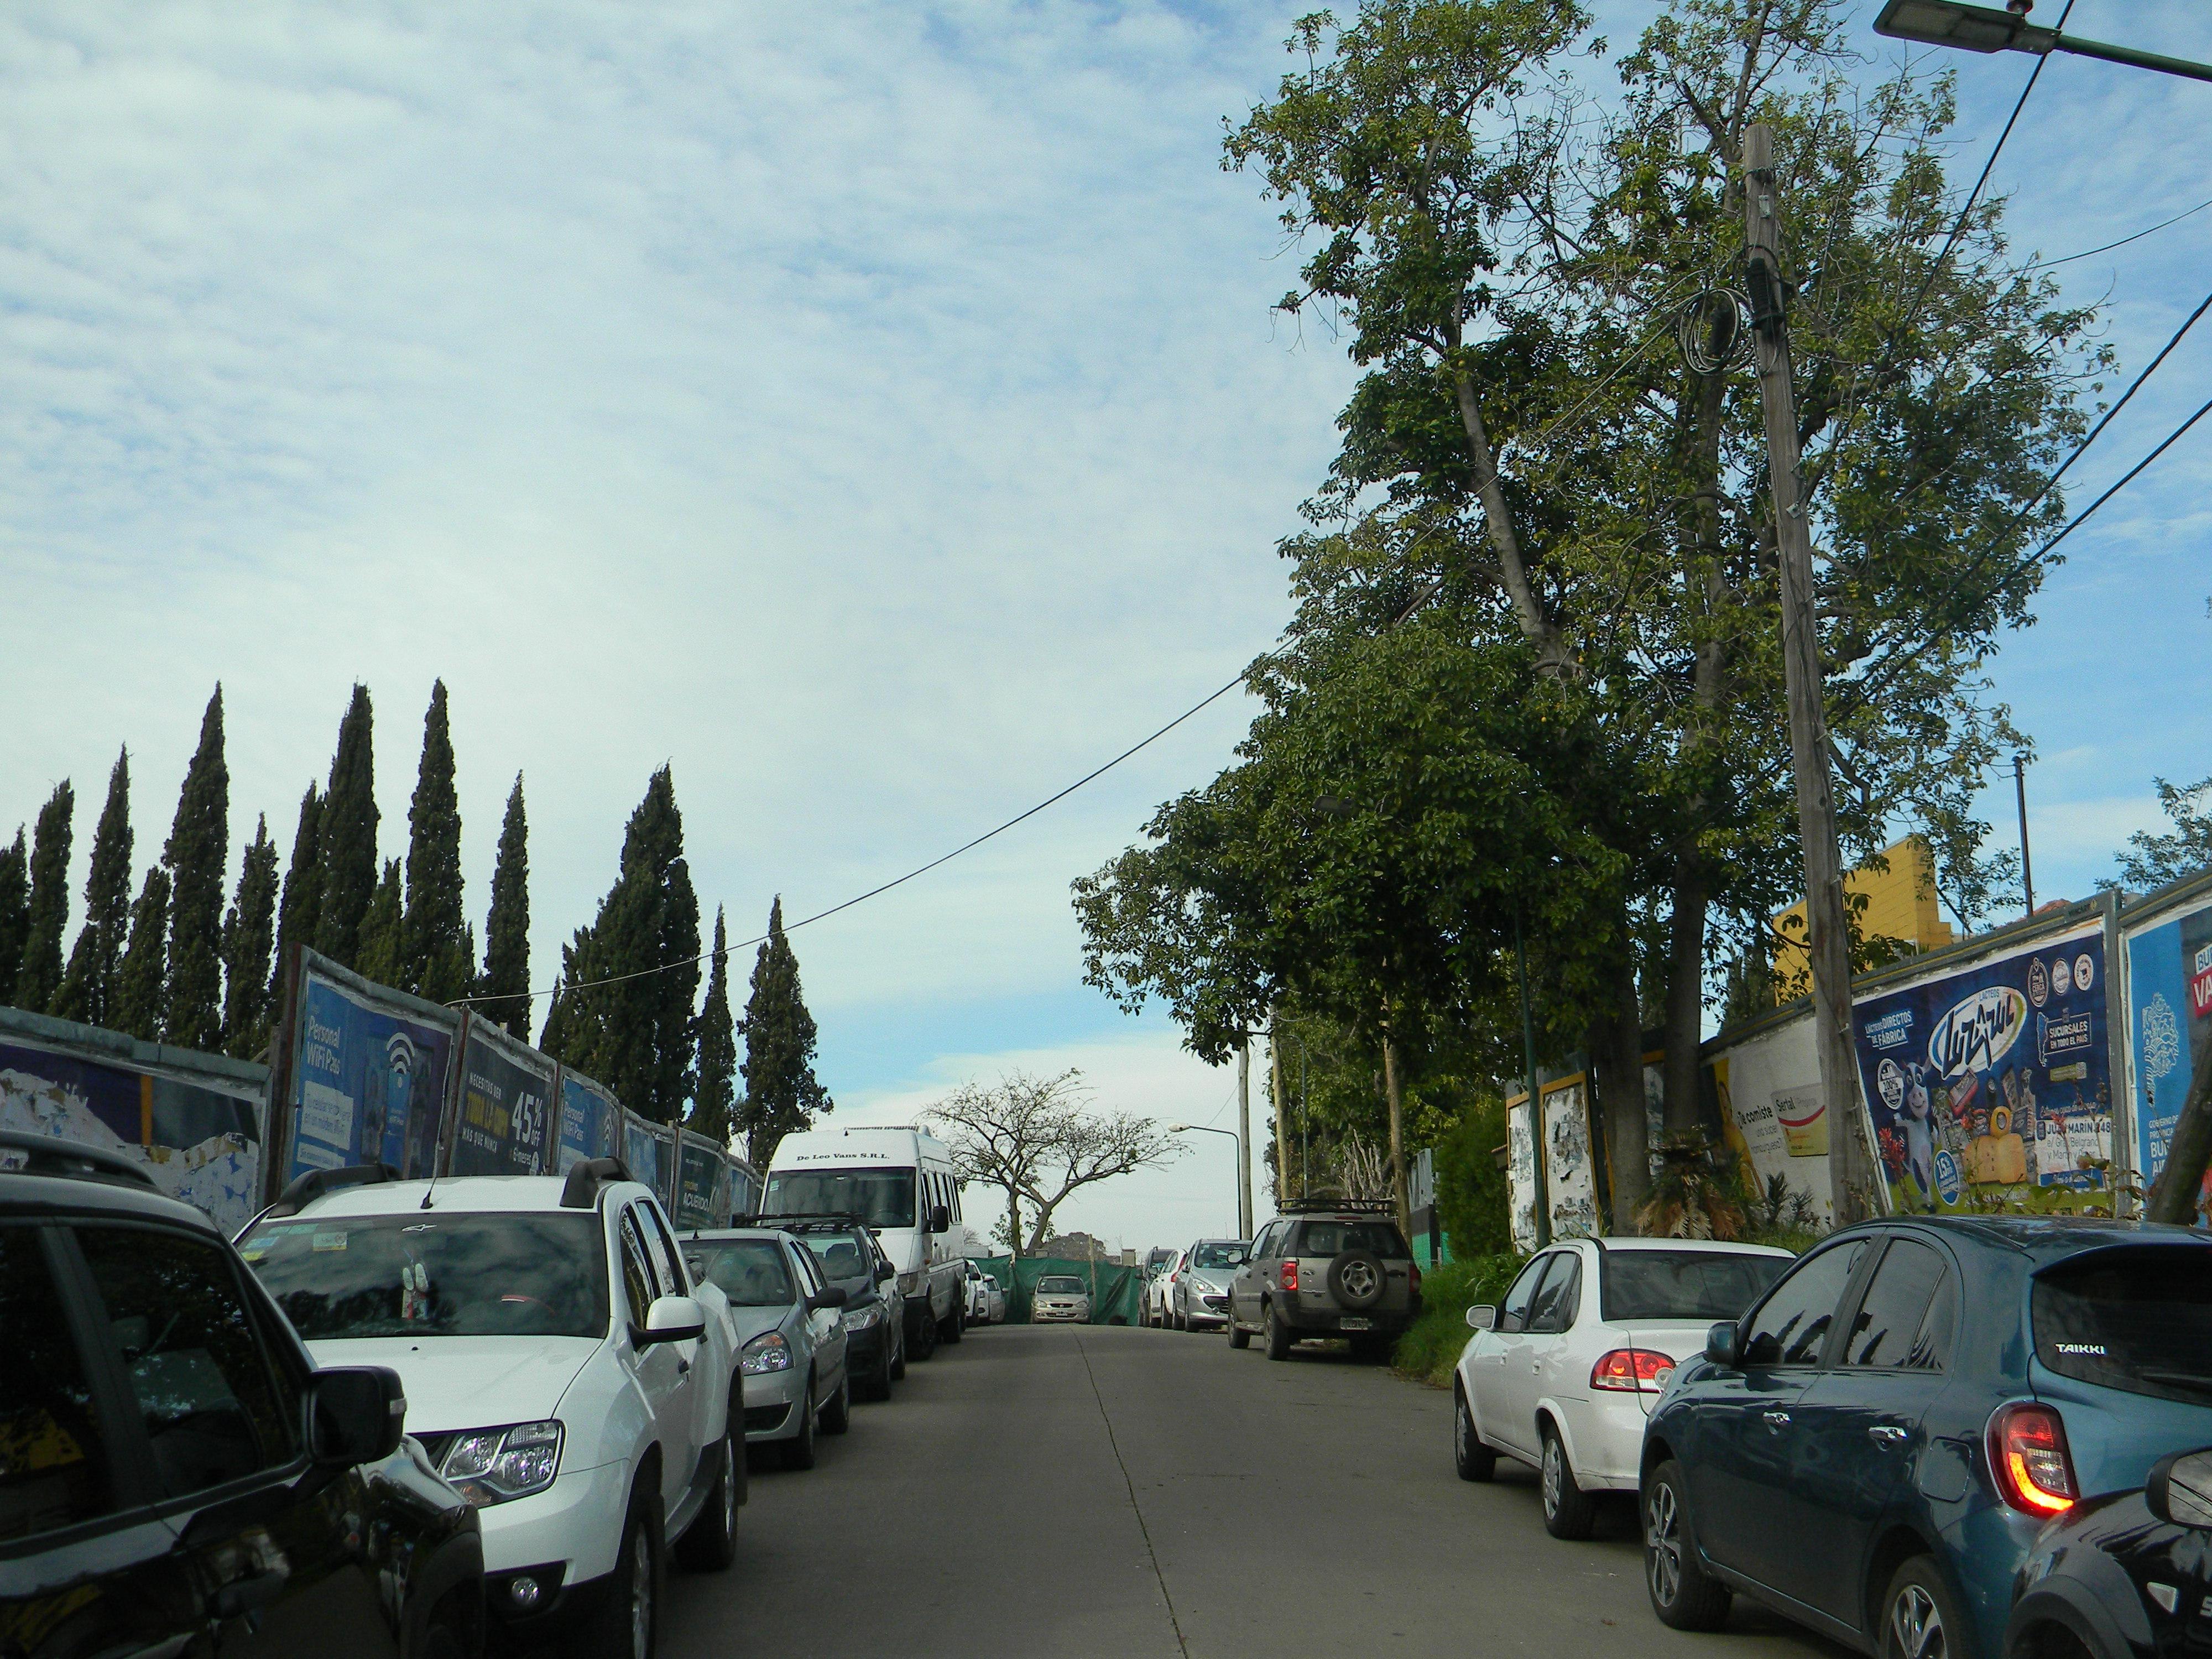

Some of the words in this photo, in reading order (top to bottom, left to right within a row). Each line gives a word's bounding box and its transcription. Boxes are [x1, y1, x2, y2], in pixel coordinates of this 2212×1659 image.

[1881, 1010, 1912, 1029] DIRECTOS
[309, 1015, 341, 1048] Personal
[1878, 1027, 1907, 1046] FÁBRICA
[2049, 1020, 2088, 1039] SUCURSALES
[2050, 1040, 2057, 1050] EN
[2057, 1037, 2069, 1048] TODO
[2070, 1036, 2076, 1046] EL
[1775, 1097, 1796, 1112] Sertal
[1745, 1105, 1773, 1123] comiste
[2068, 1120, 2093, 1134] MARÍN
[2055, 1344, 2105, 1355] TAIKKI
